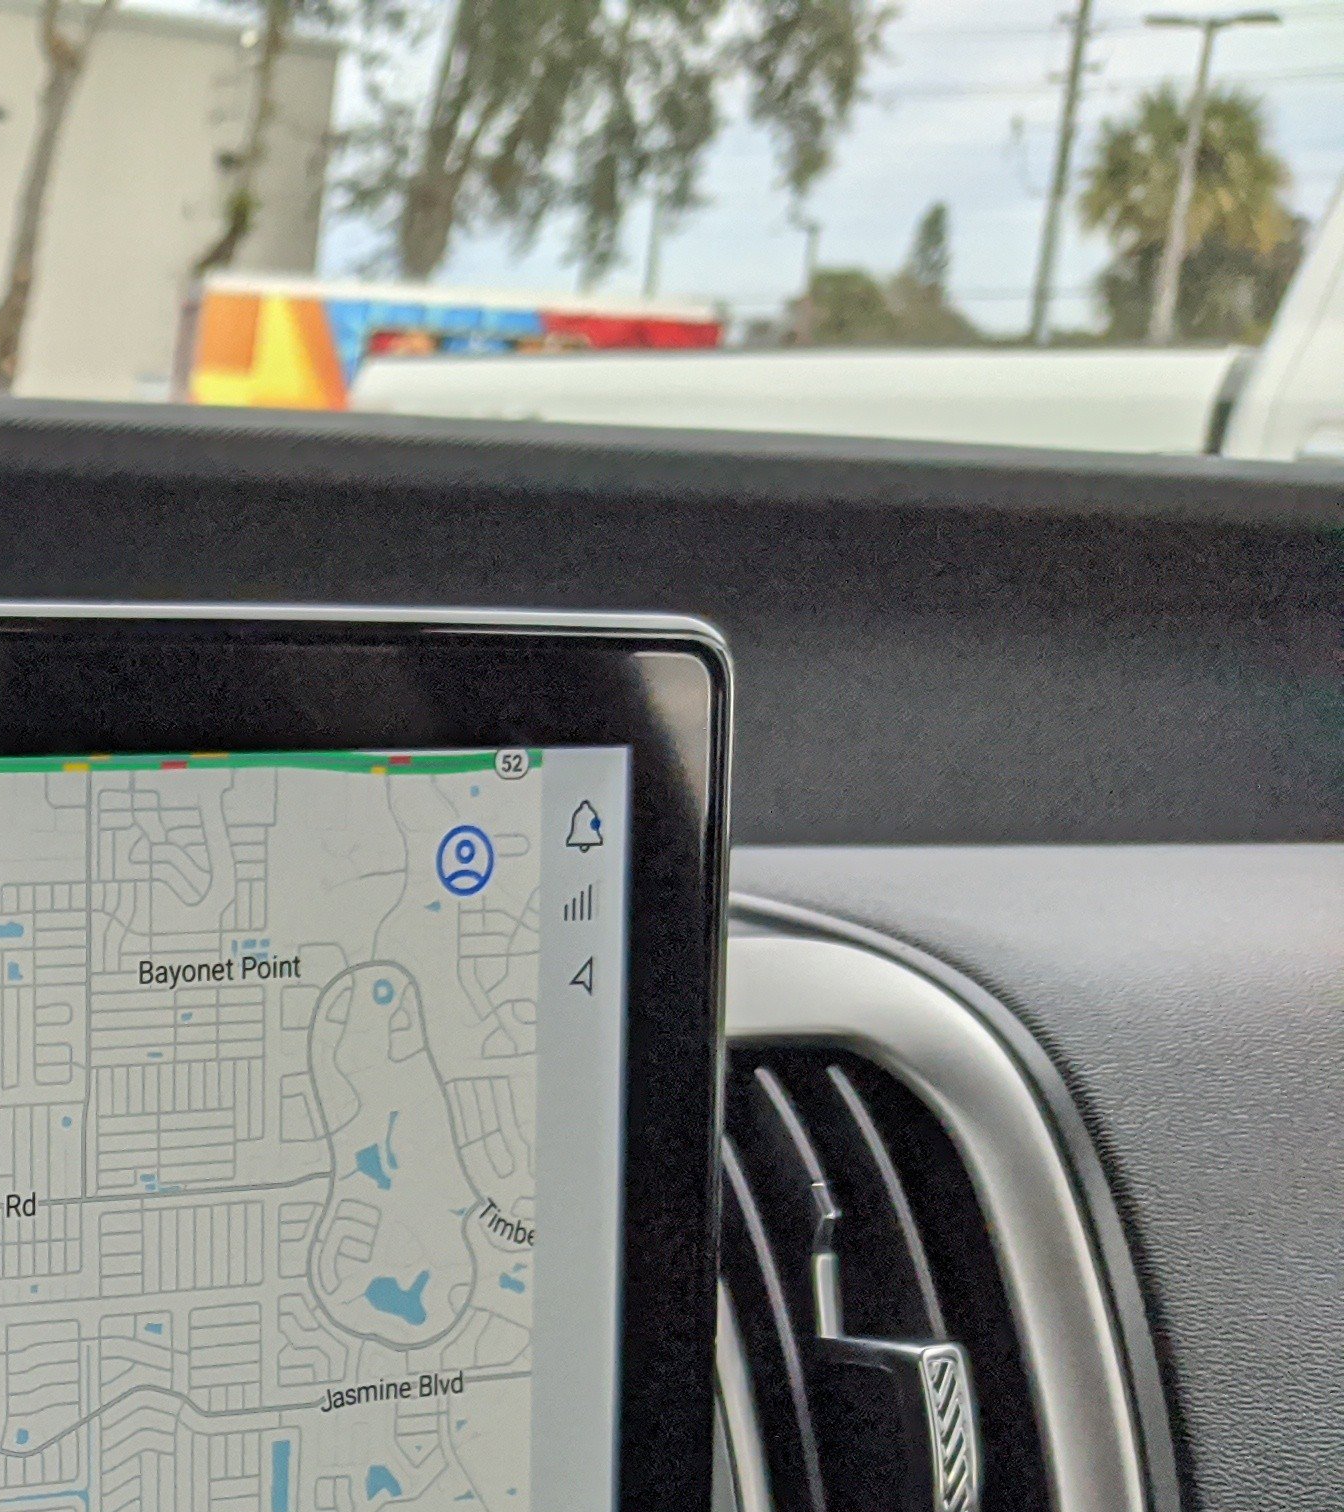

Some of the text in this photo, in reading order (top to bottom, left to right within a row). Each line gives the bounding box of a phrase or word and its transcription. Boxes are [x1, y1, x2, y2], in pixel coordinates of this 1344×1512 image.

[501, 754, 523, 774] 52
[138, 954, 302, 989] Bayonet Point
[5, 1192, 37, 1218] Rd
[320, 1370, 464, 1413] Jasmine Blvd
